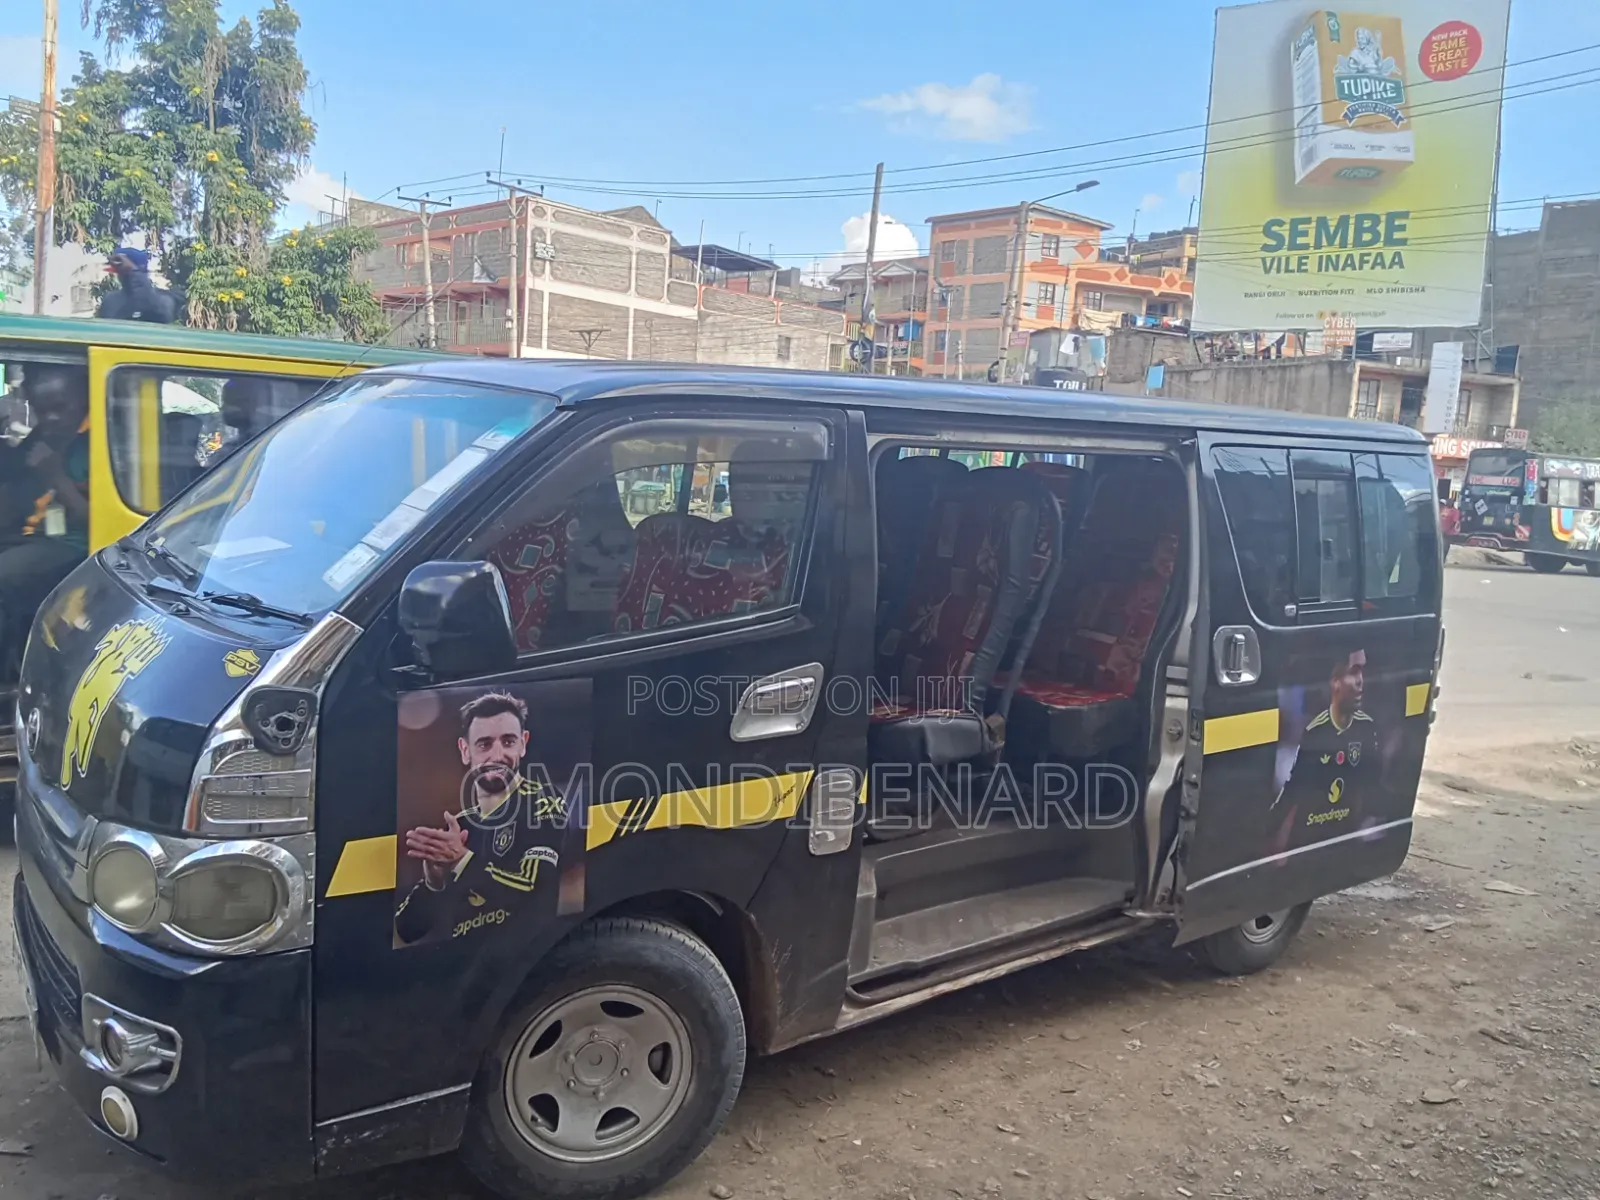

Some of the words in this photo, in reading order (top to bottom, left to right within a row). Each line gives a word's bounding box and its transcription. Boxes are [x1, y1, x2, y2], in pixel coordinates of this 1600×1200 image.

[1432, 37, 1467, 52] SAME
[1429, 47, 1469, 63] GREAT
[1429, 57, 1468, 74] TASTE
[1340, 78, 1397, 100] TUPIKE
[1260, 210, 1410, 253] SEMBE
[1261, 255, 1310, 275] VILE
[1317, 251, 1405, 273] INAFAA
[1298, 288, 1338, 296] NUTRITION
[1366, 287, 1384, 295] MLO
[1385, 285, 1426, 295] SHIBISHA
[1324, 317, 1356, 328] CYBER
[1430, 437, 1458, 455] ING
[226, 654, 257, 671] PSV
[452, 908, 511, 938] apdrag
